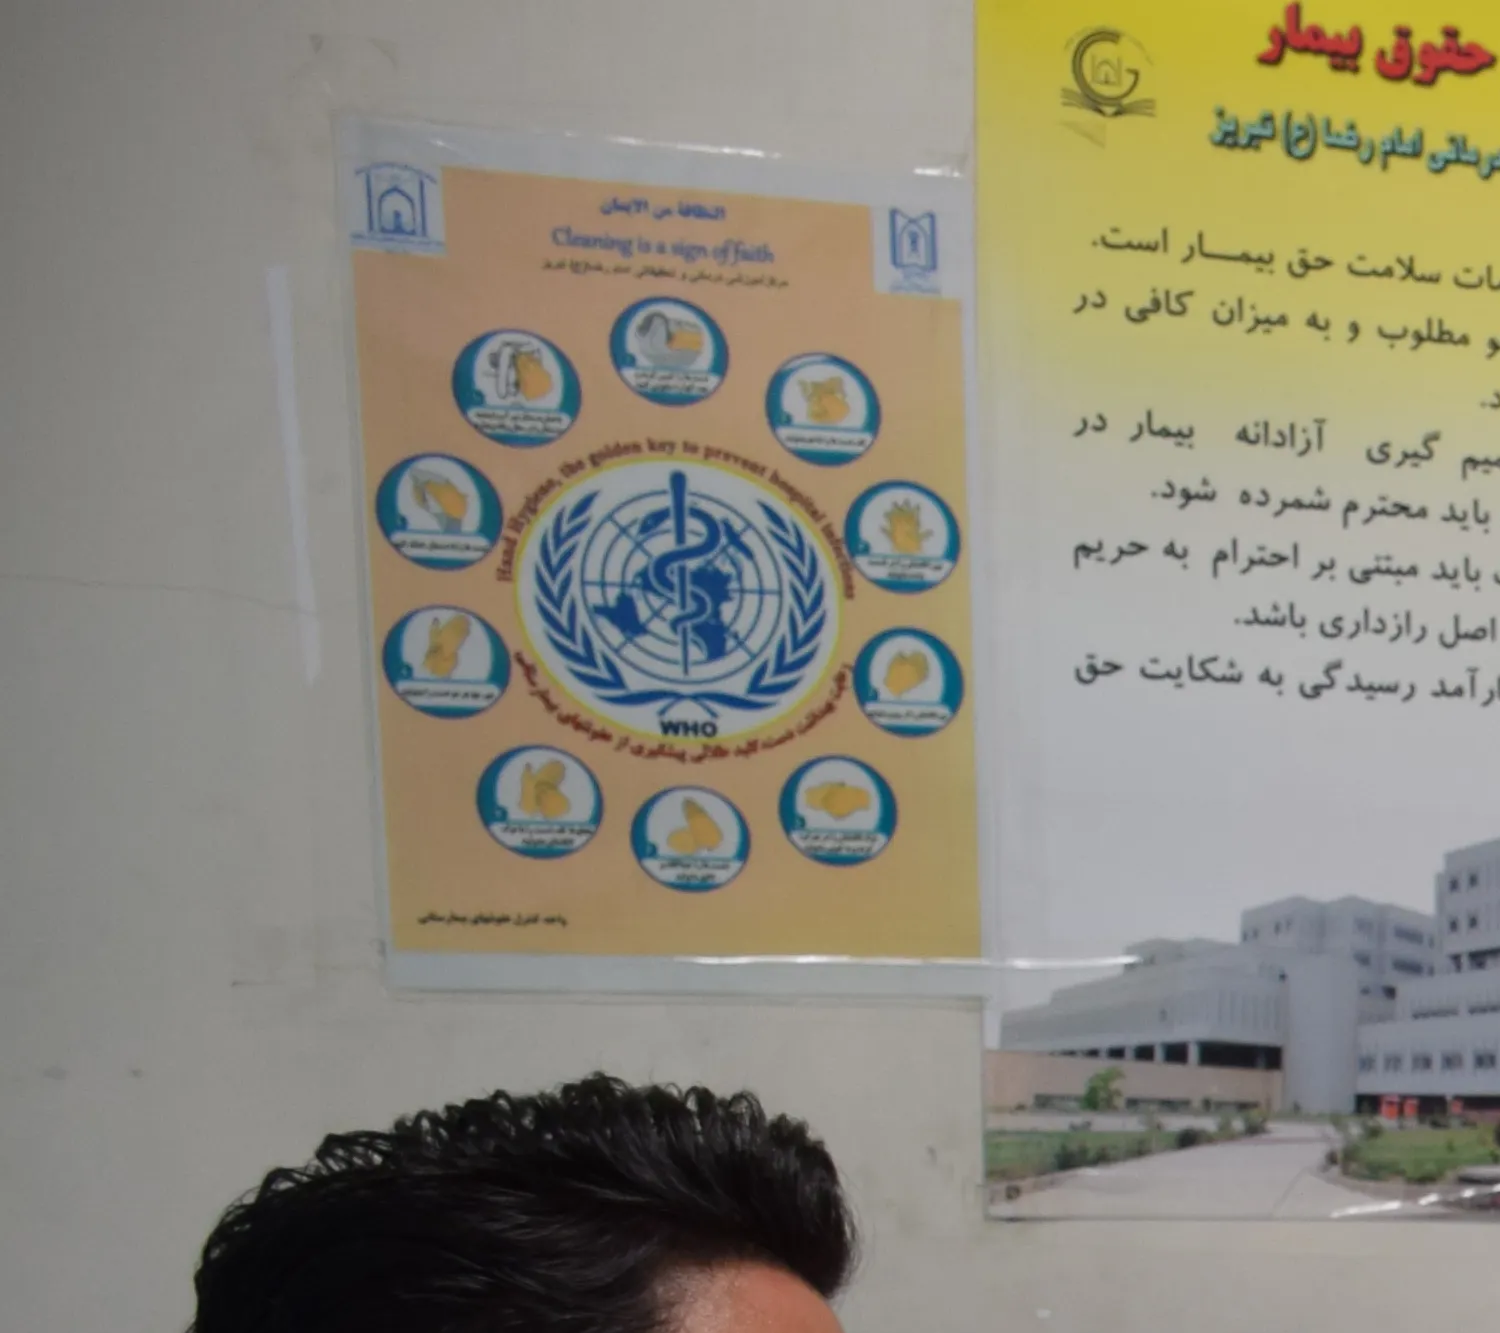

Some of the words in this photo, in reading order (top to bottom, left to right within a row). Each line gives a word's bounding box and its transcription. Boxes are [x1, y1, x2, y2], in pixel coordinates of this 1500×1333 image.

[1256, 0, 1364, 76] بیمار
[1374, 22, 1497, 88] حقوق
[1210, 103, 1276, 150] تبریز
[1320, 116, 1375, 165] رضا
[1378, 127, 1425, 170] امام
[551, 226, 633, 258] Cleaning
[638, 236, 651, 254] is
[656, 241, 665, 254] a
[671, 240, 708, 263] sign
[713, 239, 735, 266] of
[731, 240, 775, 265] faith
[1091, 226, 1169, 254] است.
[1180, 229, 1276, 276] بیمار
[1286, 247, 1336, 281] حق
[1346, 254, 1443, 286] سلامت
[1072, 289, 1108, 315] در
[1123, 287, 1196, 326] کافی
[1211, 295, 1290, 335] میزان
[1304, 311, 1332, 342] به
[1346, 319, 1362, 344] و
[1376, 316, 1471, 352] مطلوب
[1072, 412, 1109, 438] در
[1128, 408, 1196, 450] بیمار
[1234, 417, 1328, 458] آزادانه
[1365, 430, 1442, 469] گیری
[495, 536, 517, 581] Hand
[509, 478, 563, 534] Hygiene,
[558, 459, 586, 479] the
[588, 441, 642, 468] golden
[647, 438, 676, 455] key
[683, 440, 699, 454] to
[704, 445, 768, 478] prevent
[1150, 476, 1218, 511] شود.
[1238, 485, 1332, 519] شمرده
[1341, 495, 1430, 530] محترم
[1439, 497, 1491, 535] باید
[1072, 539, 1150, 570] حریم
[1161, 539, 1190, 571] به
[1211, 536, 1300, 580] احترام
[1310, 556, 1337, 582] بر
[1347, 554, 1420, 587] مبتنی
[1430, 555, 1482, 593] باید
[1233, 601, 1308, 639] باشد.
[1317, 606, 1429, 645] رازداری
[1437, 613, 1498, 651] اصل
[1073, 652, 1125, 687] حق
[1138, 653, 1245, 690] شکایت
[1257, 665, 1285, 697] به
[1297, 658, 1418, 704] رسیدگی
[658, 719, 718, 738] WHO
